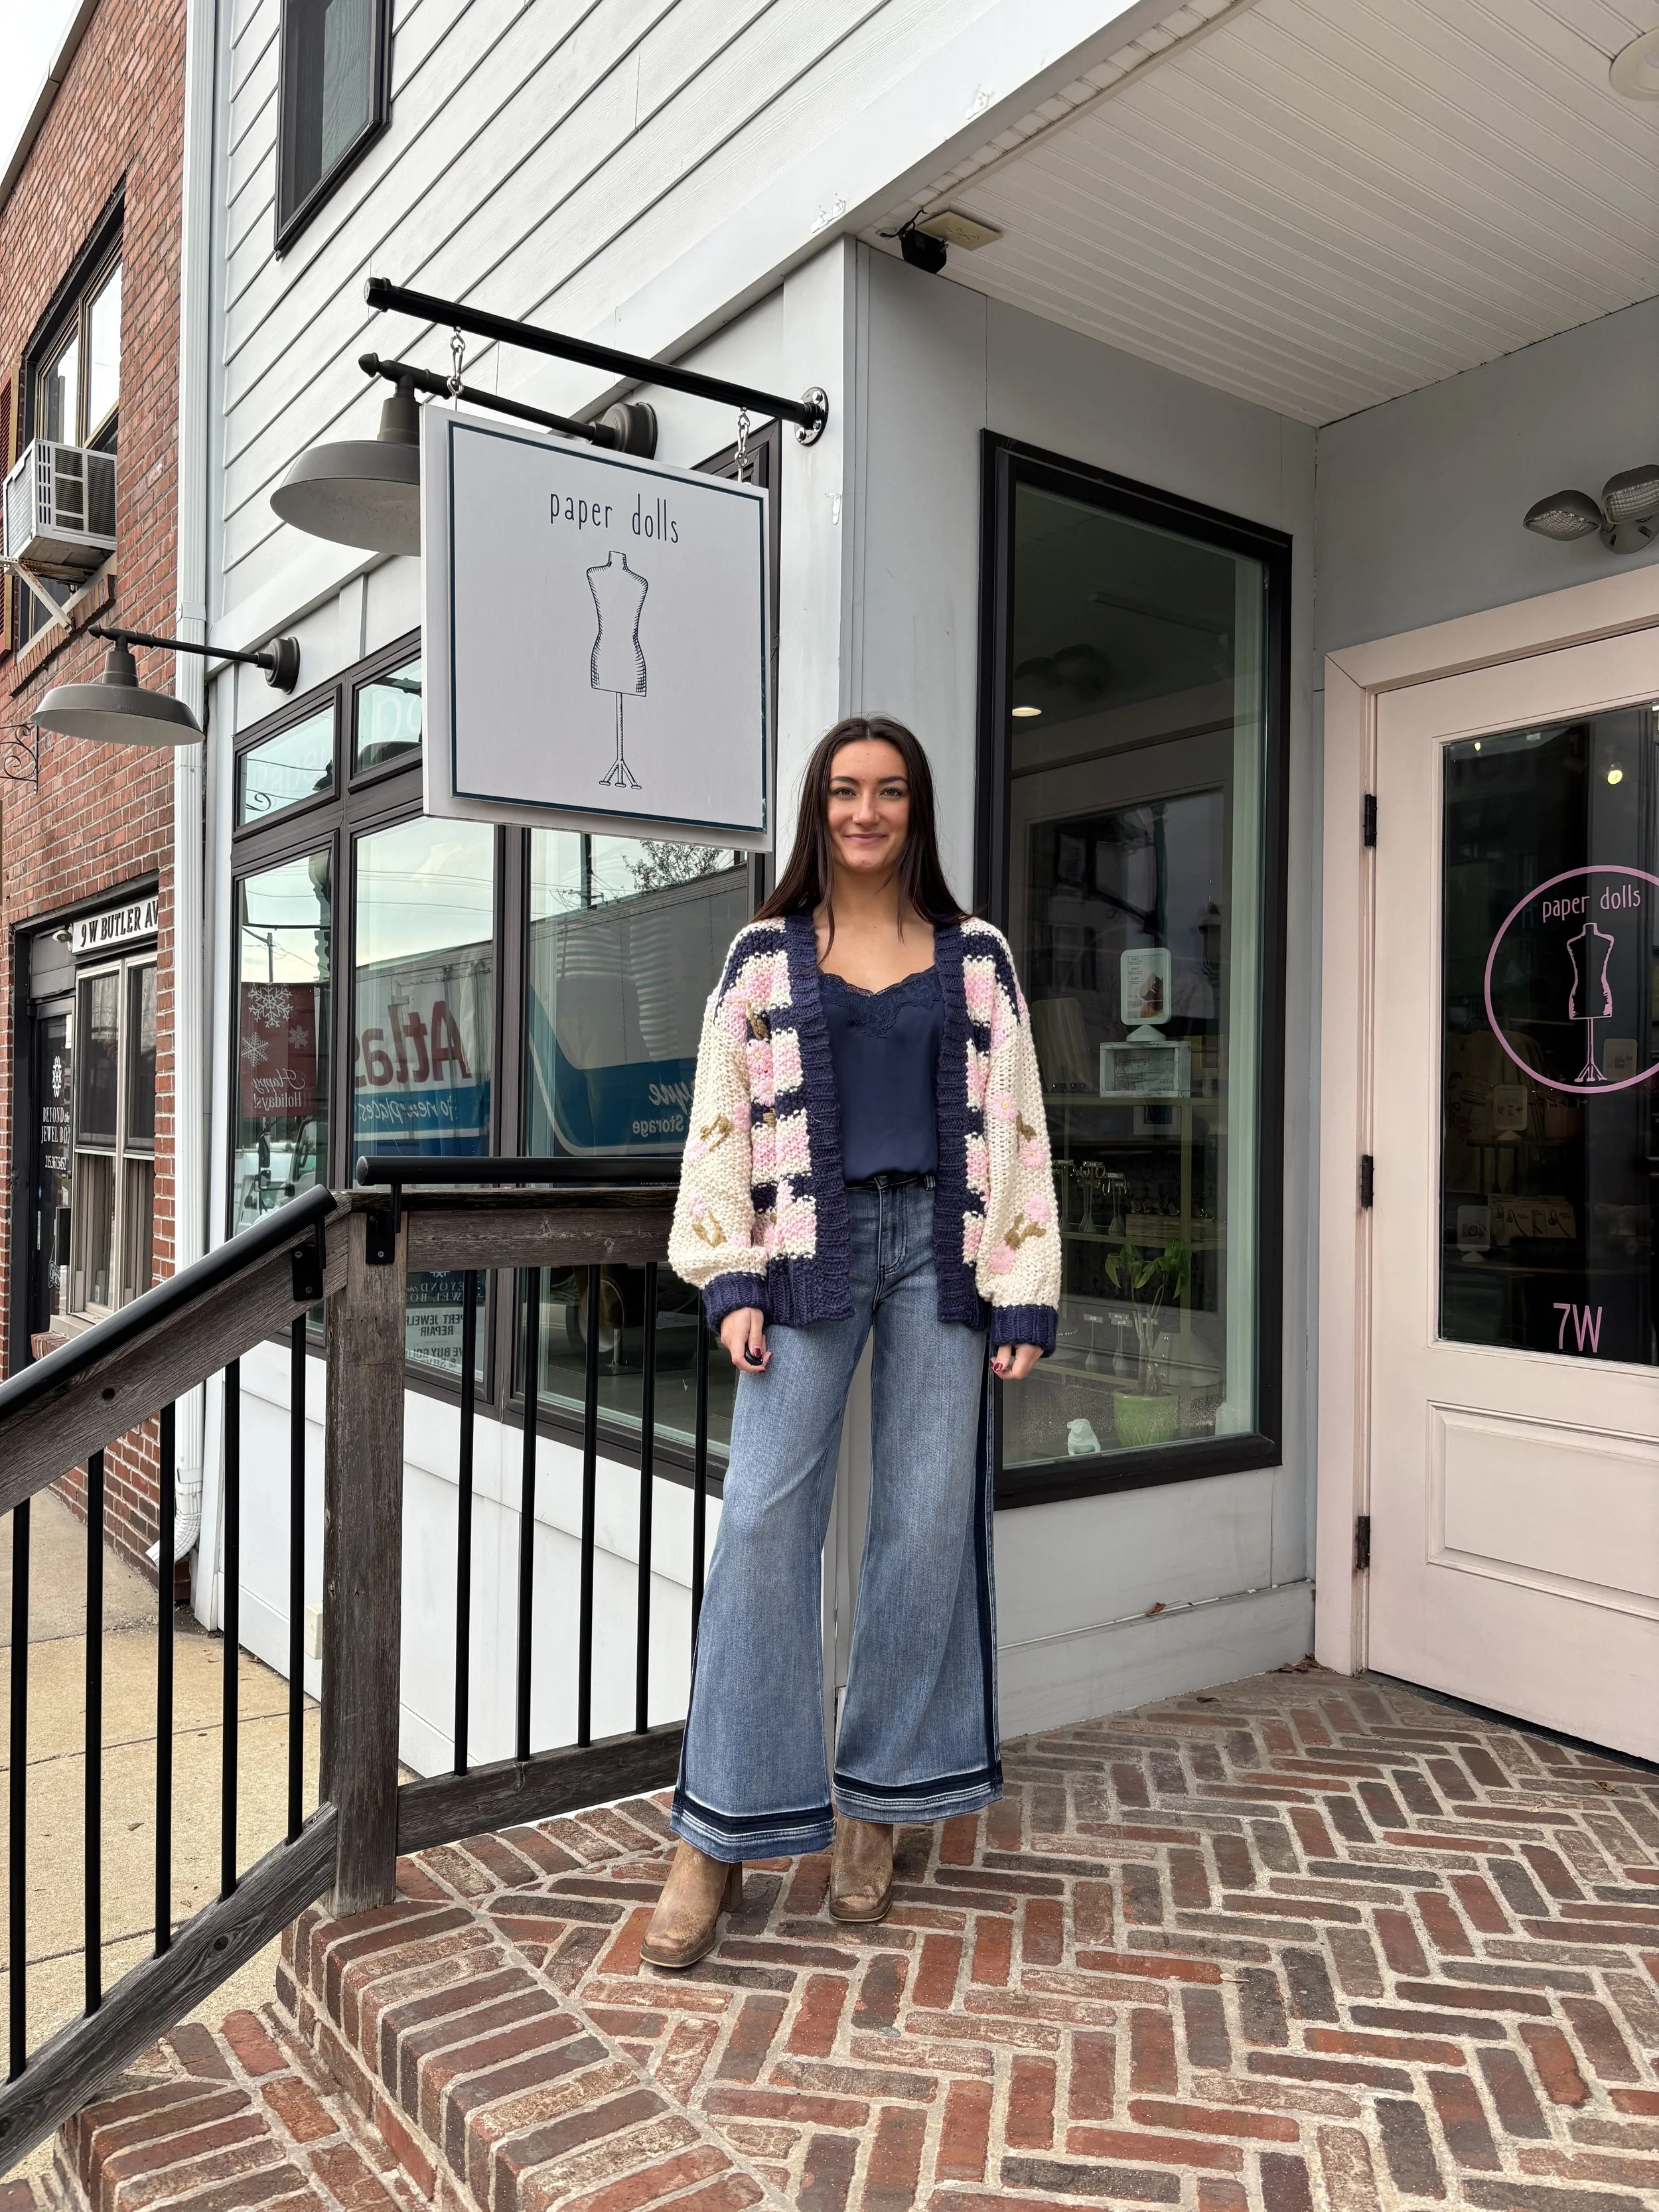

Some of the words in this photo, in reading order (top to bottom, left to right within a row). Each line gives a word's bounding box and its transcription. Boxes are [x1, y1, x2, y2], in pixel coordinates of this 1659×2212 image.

[550, 493, 613, 530] paper
[632, 493, 679, 544] dolls
[1542, 896, 1591, 923] paper
[1600, 884, 1641, 910] dolls
[80, 924, 87, 948] 9
[89, 920, 99, 943] W
[100, 906, 141, 940] BUTLER
[42, 1106, 64, 1123] BEYOND
[41, 1126, 58, 1144] JEWEL
[1553, 1302, 1603, 1353] 7W
